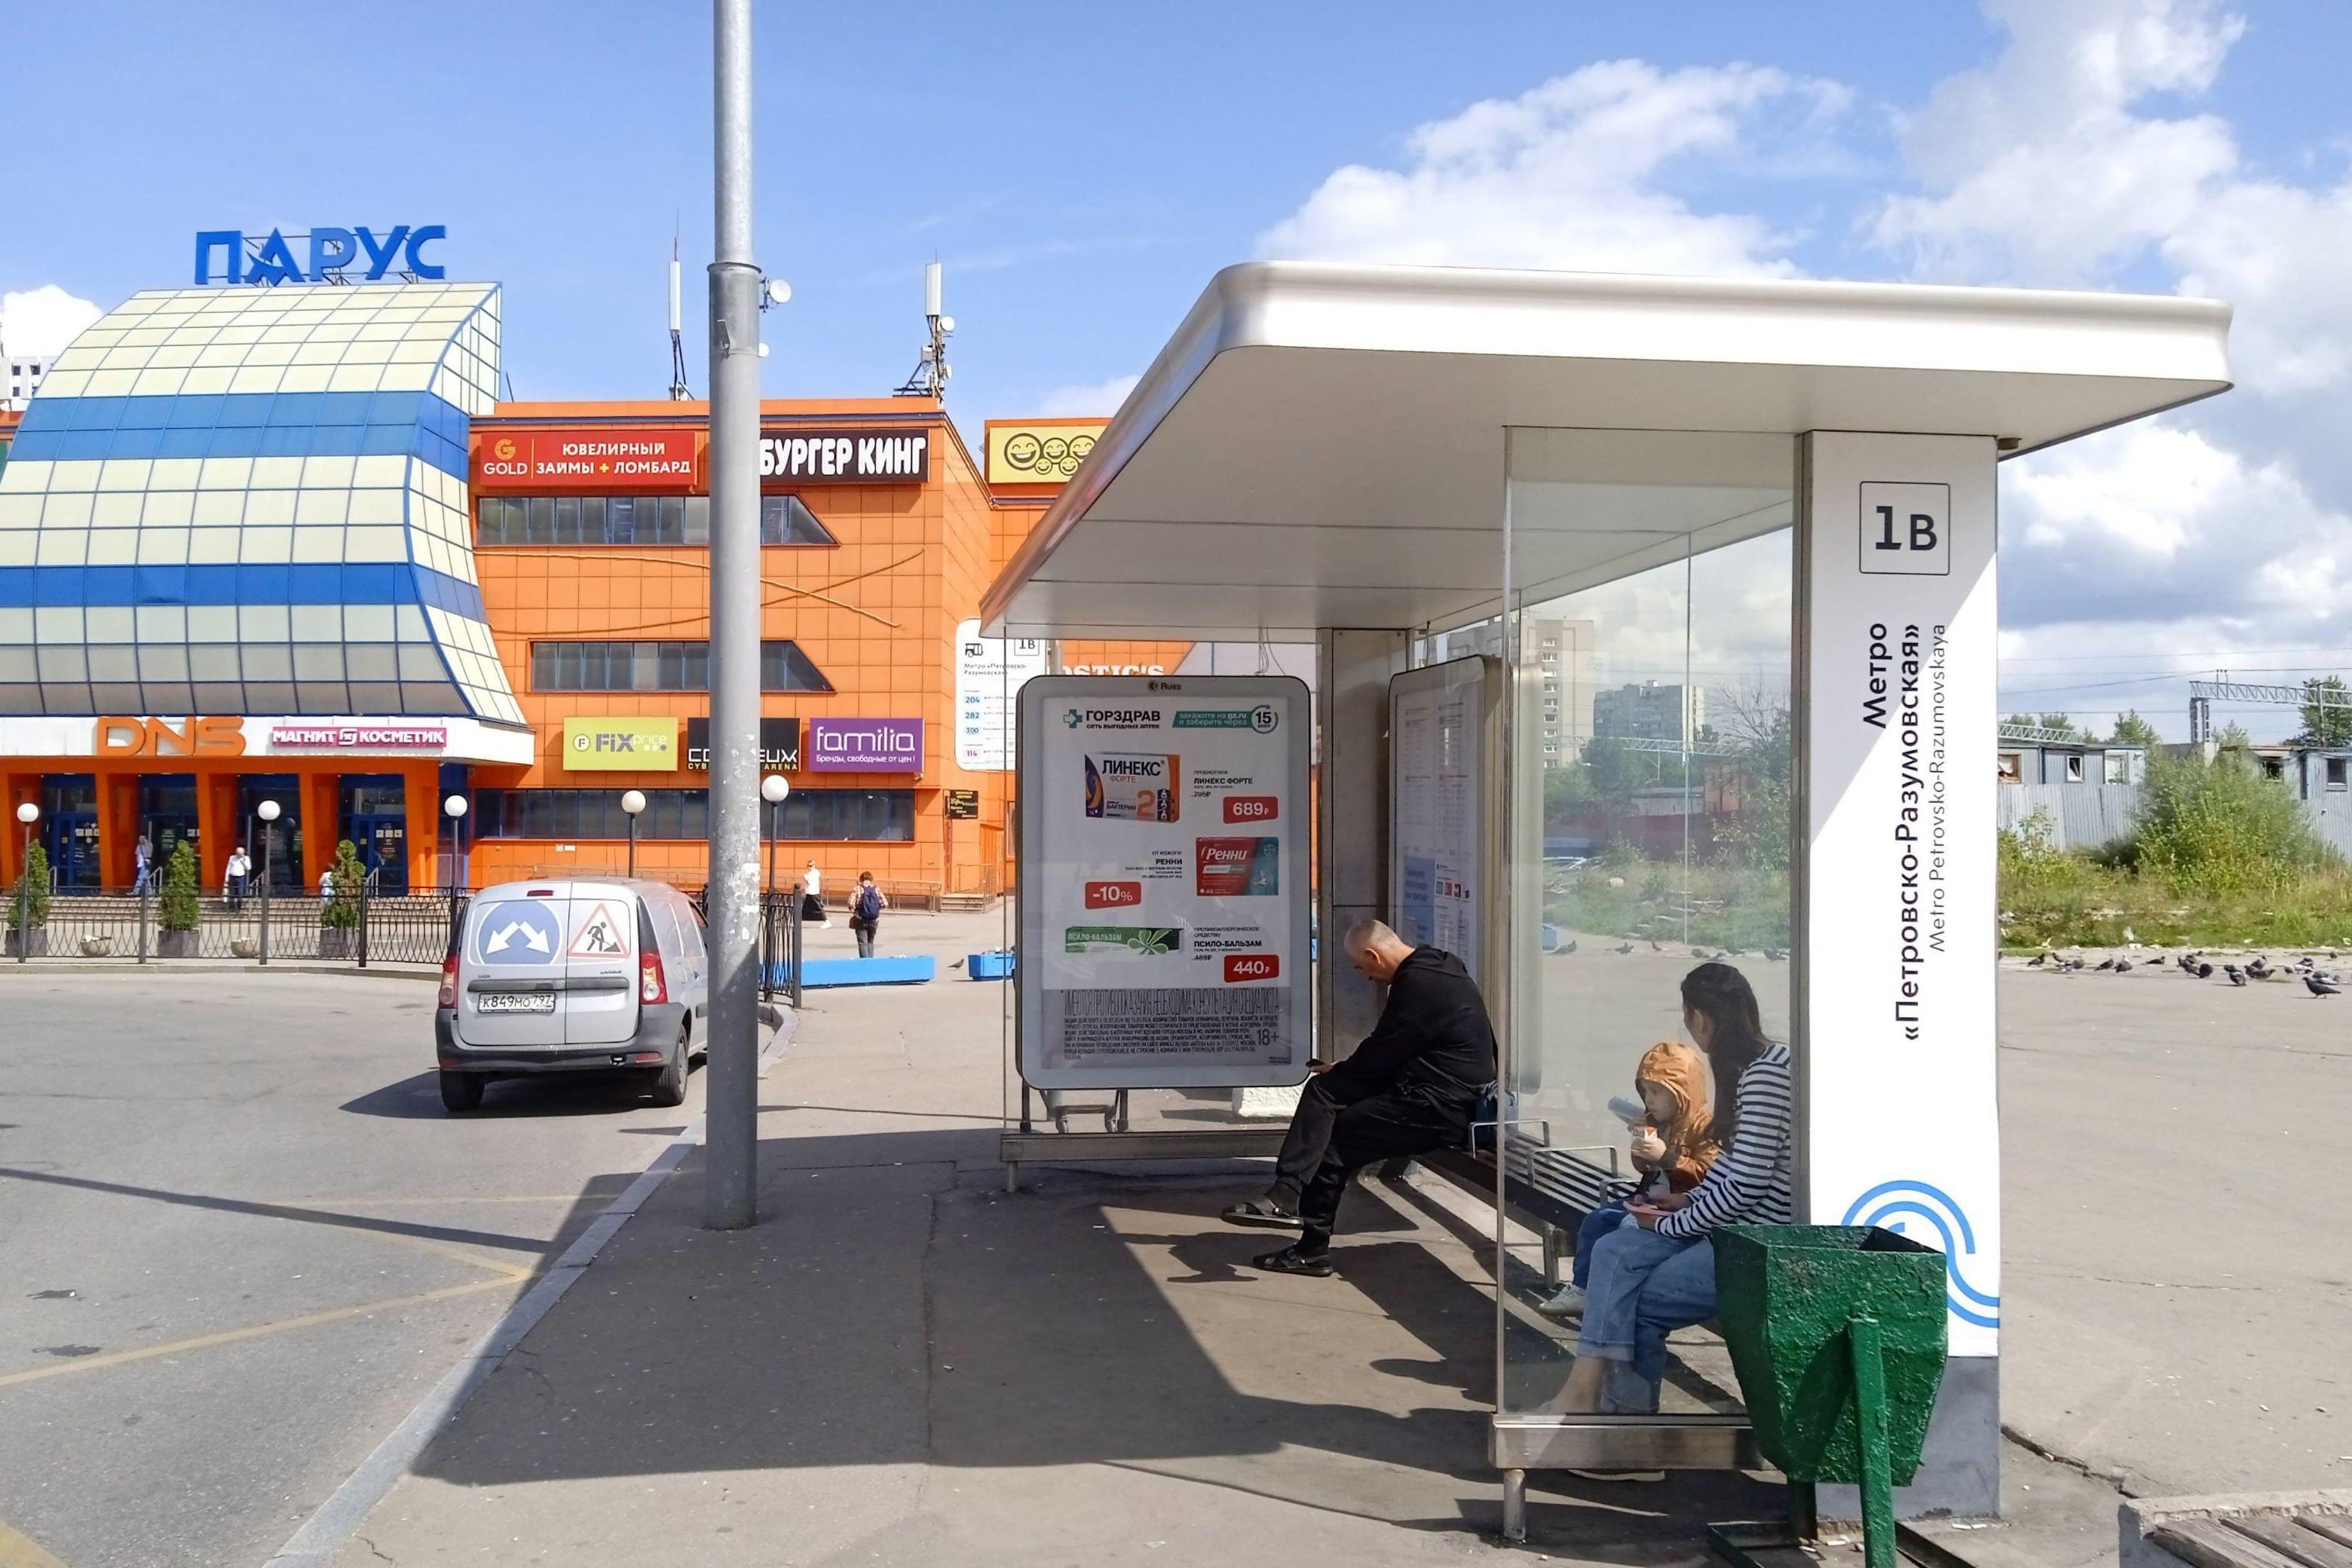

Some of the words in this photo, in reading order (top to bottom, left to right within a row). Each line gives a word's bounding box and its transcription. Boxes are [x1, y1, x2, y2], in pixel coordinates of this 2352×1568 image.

[194, 225, 446, 285] ПАРУС
[562, 443, 665, 455] ЮВЕЛИРНЫЙ
[760, 438, 853, 476] БУРГЕР
[858, 437, 926, 475] КИНГ
[483, 462, 528, 475] GOLD
[536, 461, 594, 474] ЗАЙМЫ
[614, 461, 691, 473] ЛОМБАРД
[1863, 623, 1893, 729] Метро
[1086, 711, 1161, 722] ГОРЗДРАВ
[1255, 711, 1272, 724] 15
[97, 716, 247, 756] DNS
[272, 730, 337, 743] МАГНИТ
[359, 730, 445, 743] КОСМЕТИК
[816, 726, 915, 752] familia
[847, 755, 887, 763] свободные
[1928, 625, 1949, 880] Petrovsko-Razumovskaya
[1102, 760, 1161, 776] ЛИНЕКС
[1895, 624, 1924, 1040] «Петровско-Разумовская»
[1206, 848, 1248, 860] Ренни
[1929, 888, 1945, 952] Metro
[1067, 933, 1122, 942] ПСИЛО-БАЛЬЗАМ
[1257, 1028, 1279, 1046] 18+
